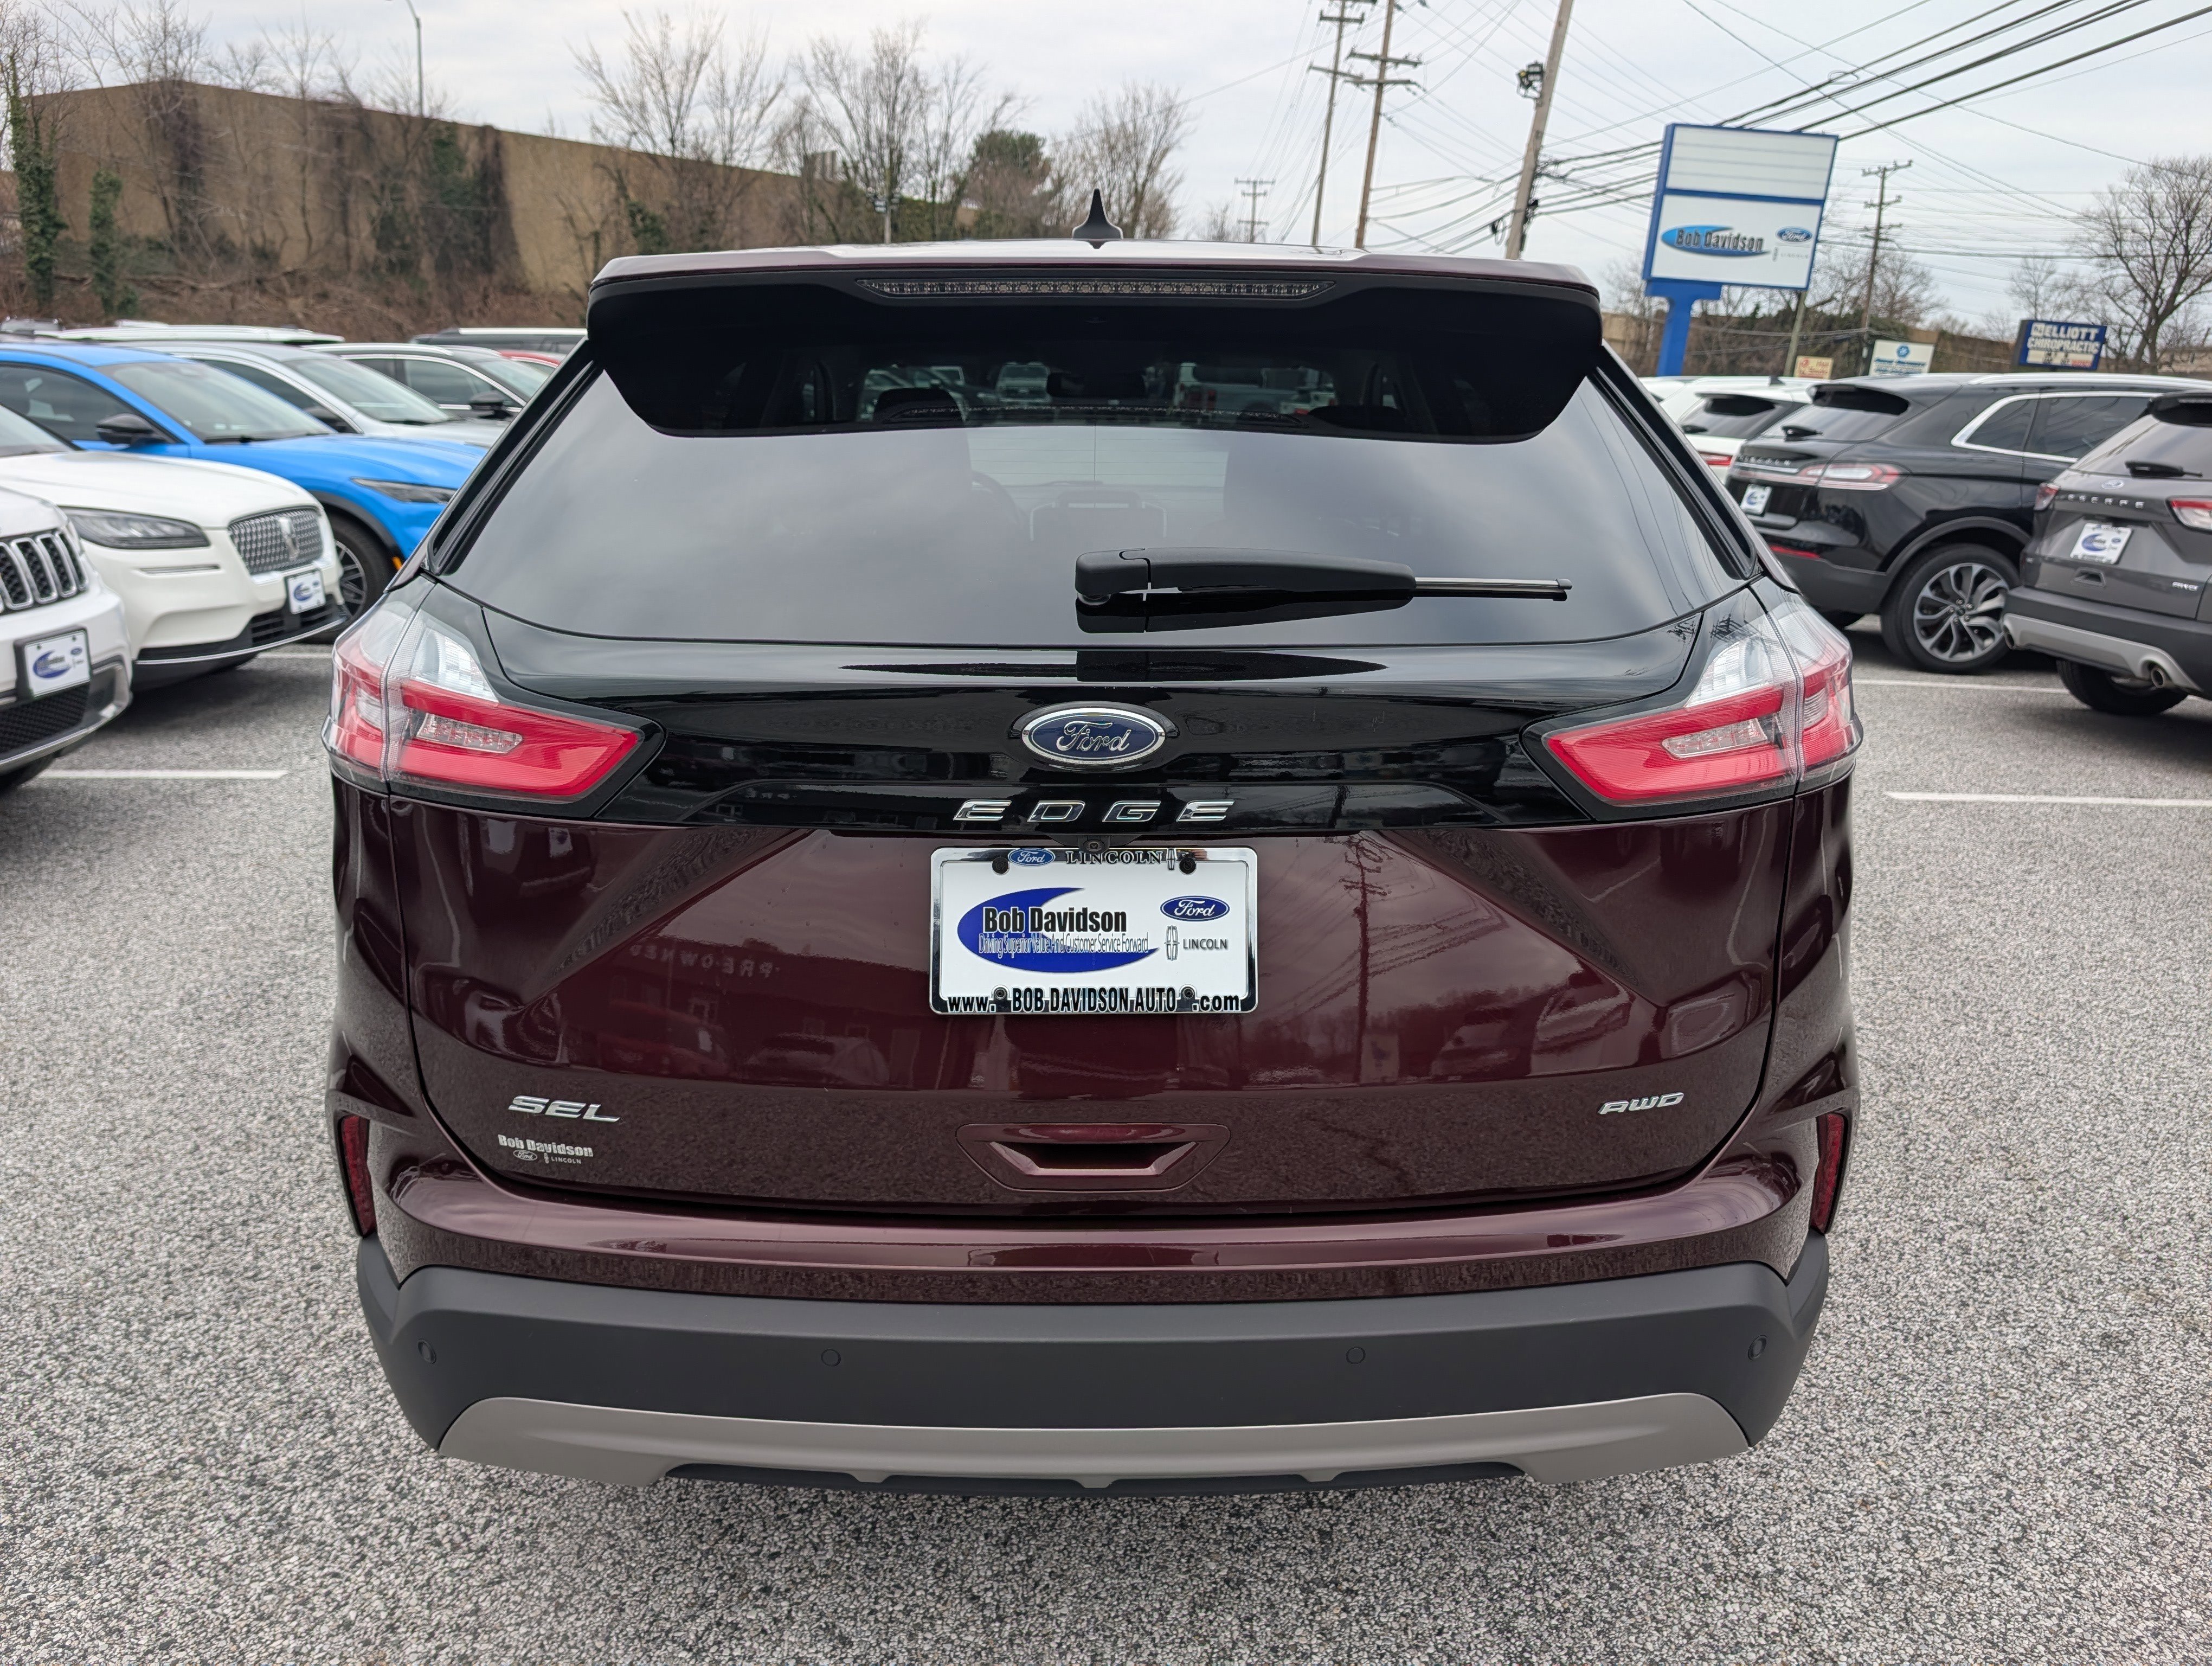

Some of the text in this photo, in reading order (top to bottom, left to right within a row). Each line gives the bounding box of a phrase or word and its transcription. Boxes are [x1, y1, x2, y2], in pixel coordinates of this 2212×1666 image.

[1676, 229, 1764, 252] Bob Davidson
[2044, 324, 2099, 341] ELLIOTT
[2027, 337, 2100, 354] CHIROPRACTIC
[1056, 720, 1132, 752] Ford
[953, 799, 1235, 822] EDGE
[1066, 850, 1163, 864] LINCOLN
[983, 906, 1127, 933] Bob Davidson
[1174, 899, 1216, 917] Ford
[979, 932, 1148, 958] Driving Superior Value And Customer Service Forward
[1182, 938, 1228, 950] LINCOLN
[947, 986, 1240, 1013] www. BOB DAVIDSON AUTO .com
[508, 1095, 620, 1123] SEL
[1598, 1092, 1684, 1115] AWD
[498, 1133, 594, 1157] Bob Davidson
[551, 1156, 582, 1164] LINCOLN
